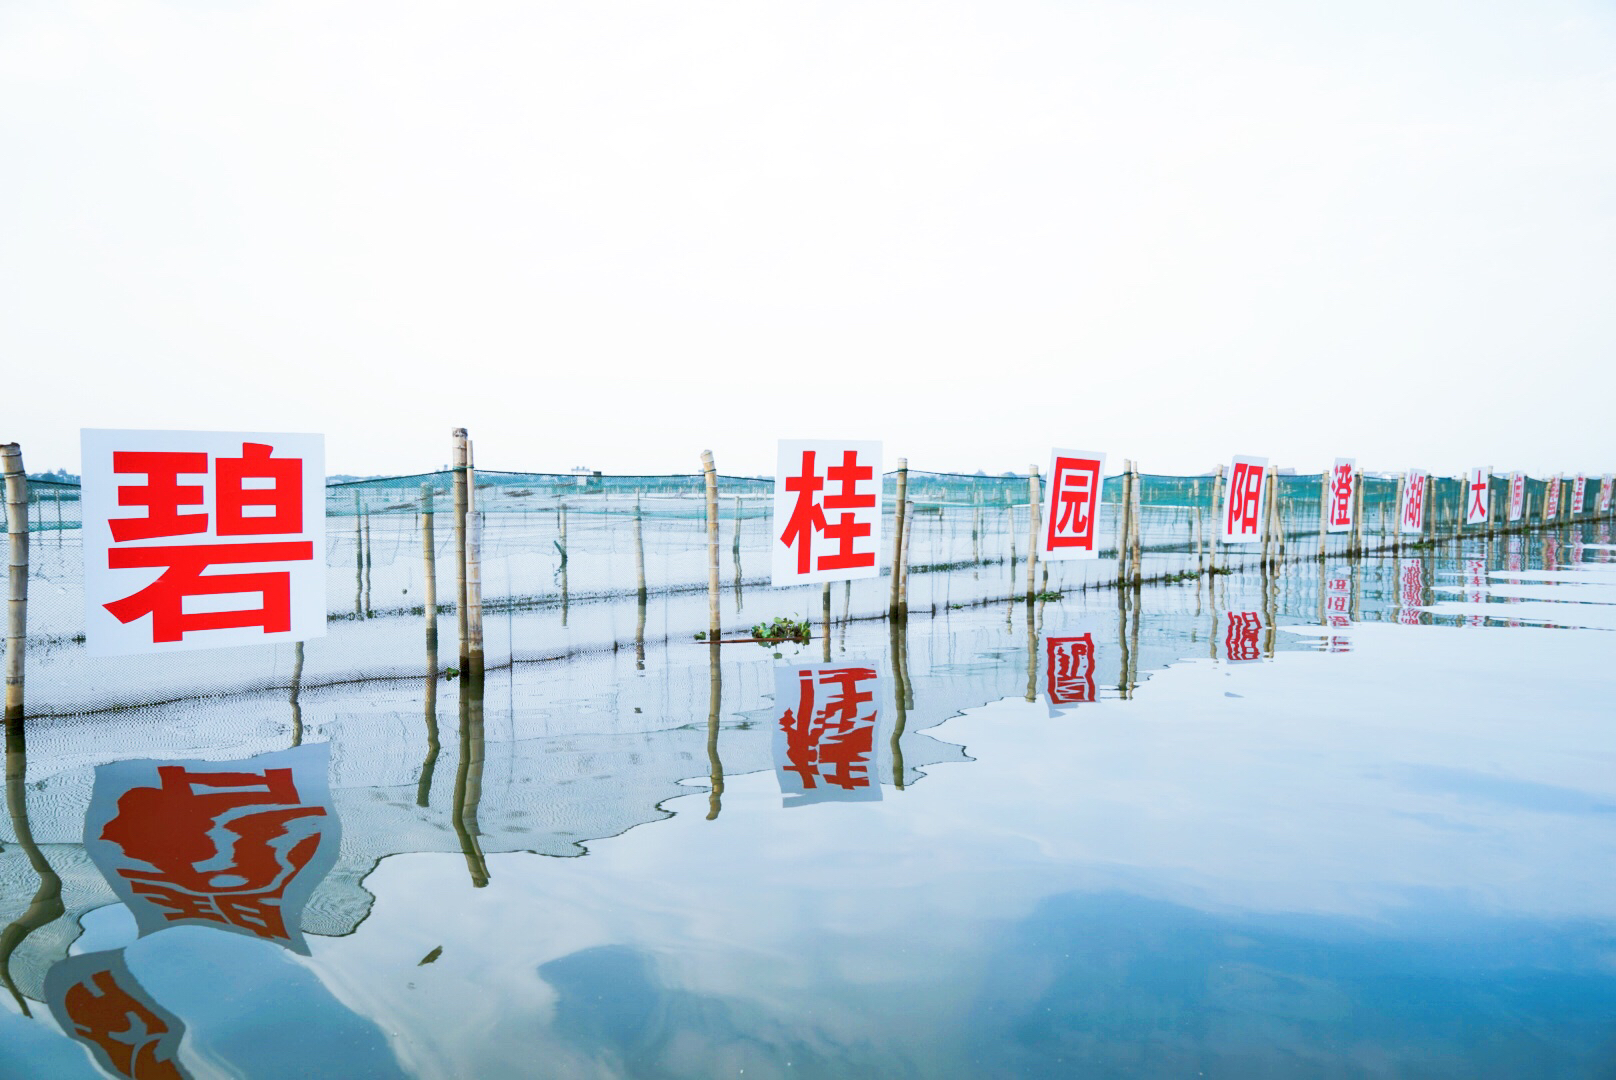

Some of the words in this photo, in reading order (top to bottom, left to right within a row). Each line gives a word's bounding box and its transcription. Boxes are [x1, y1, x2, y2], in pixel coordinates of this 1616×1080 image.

[780, 450, 876, 574] 桂
[1047, 456, 1100, 552] 园
[1228, 463, 1264, 534] 阳
[1330, 463, 1353, 526] 澄
[1404, 473, 1425, 528] 湖
[1469, 470, 1487, 519] 大
[105, 442, 313, 643] 碧
